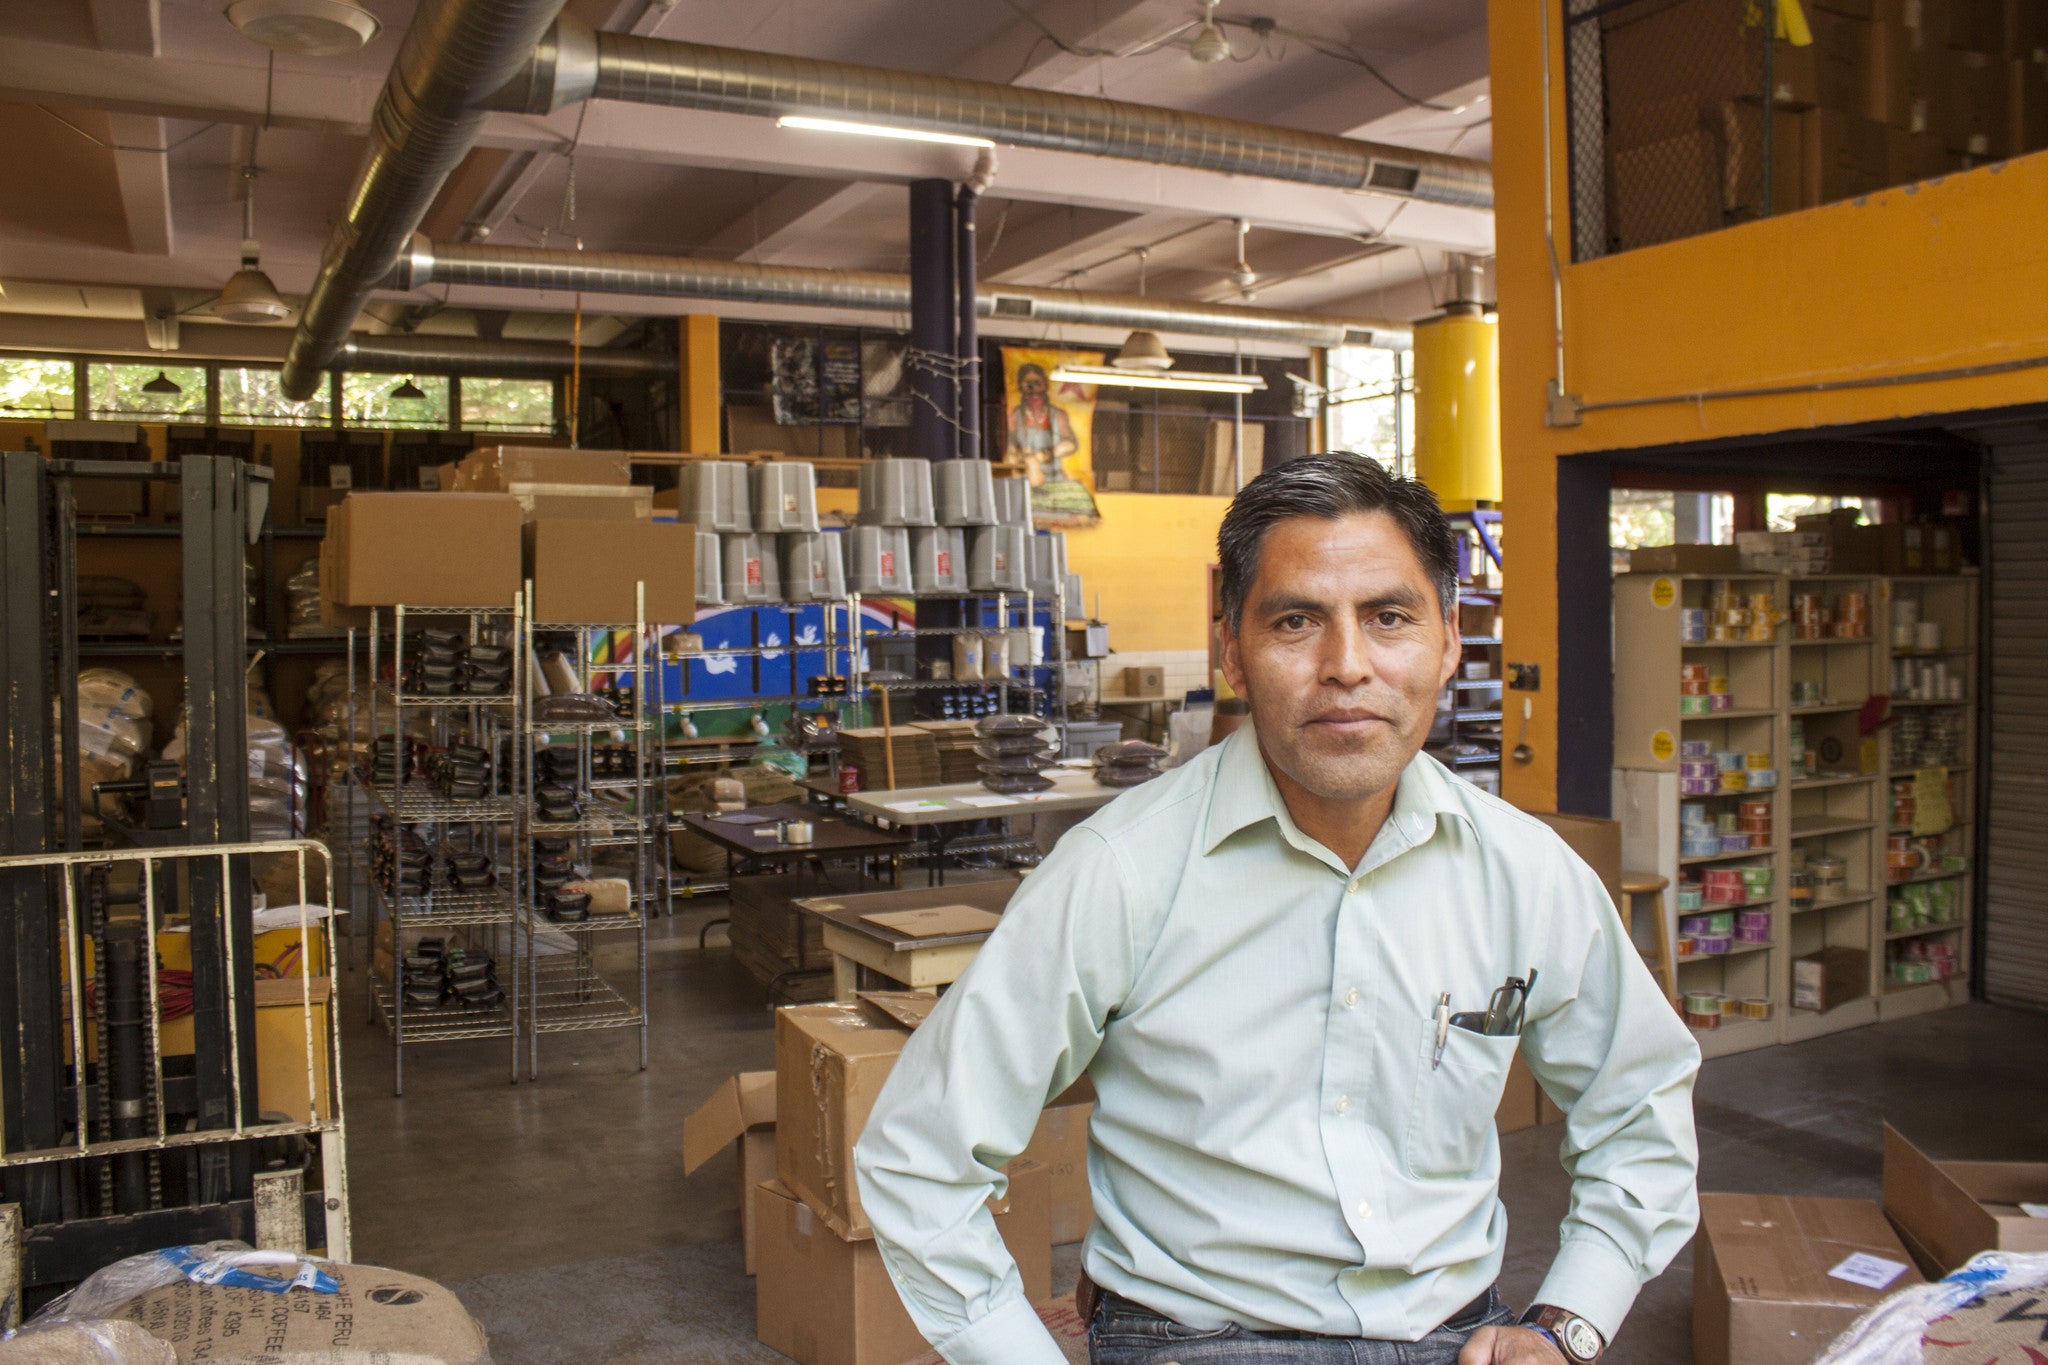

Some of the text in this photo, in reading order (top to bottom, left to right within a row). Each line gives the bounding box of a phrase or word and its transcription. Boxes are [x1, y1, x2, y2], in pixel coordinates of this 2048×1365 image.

[197, 1299, 219, 1336] Coffees
[222, 1310, 243, 1338] 4395
[314, 1301, 332, 1321] 1464
[264, 1307, 290, 1352] COFFEE
[332, 1314, 353, 1347] PERU
